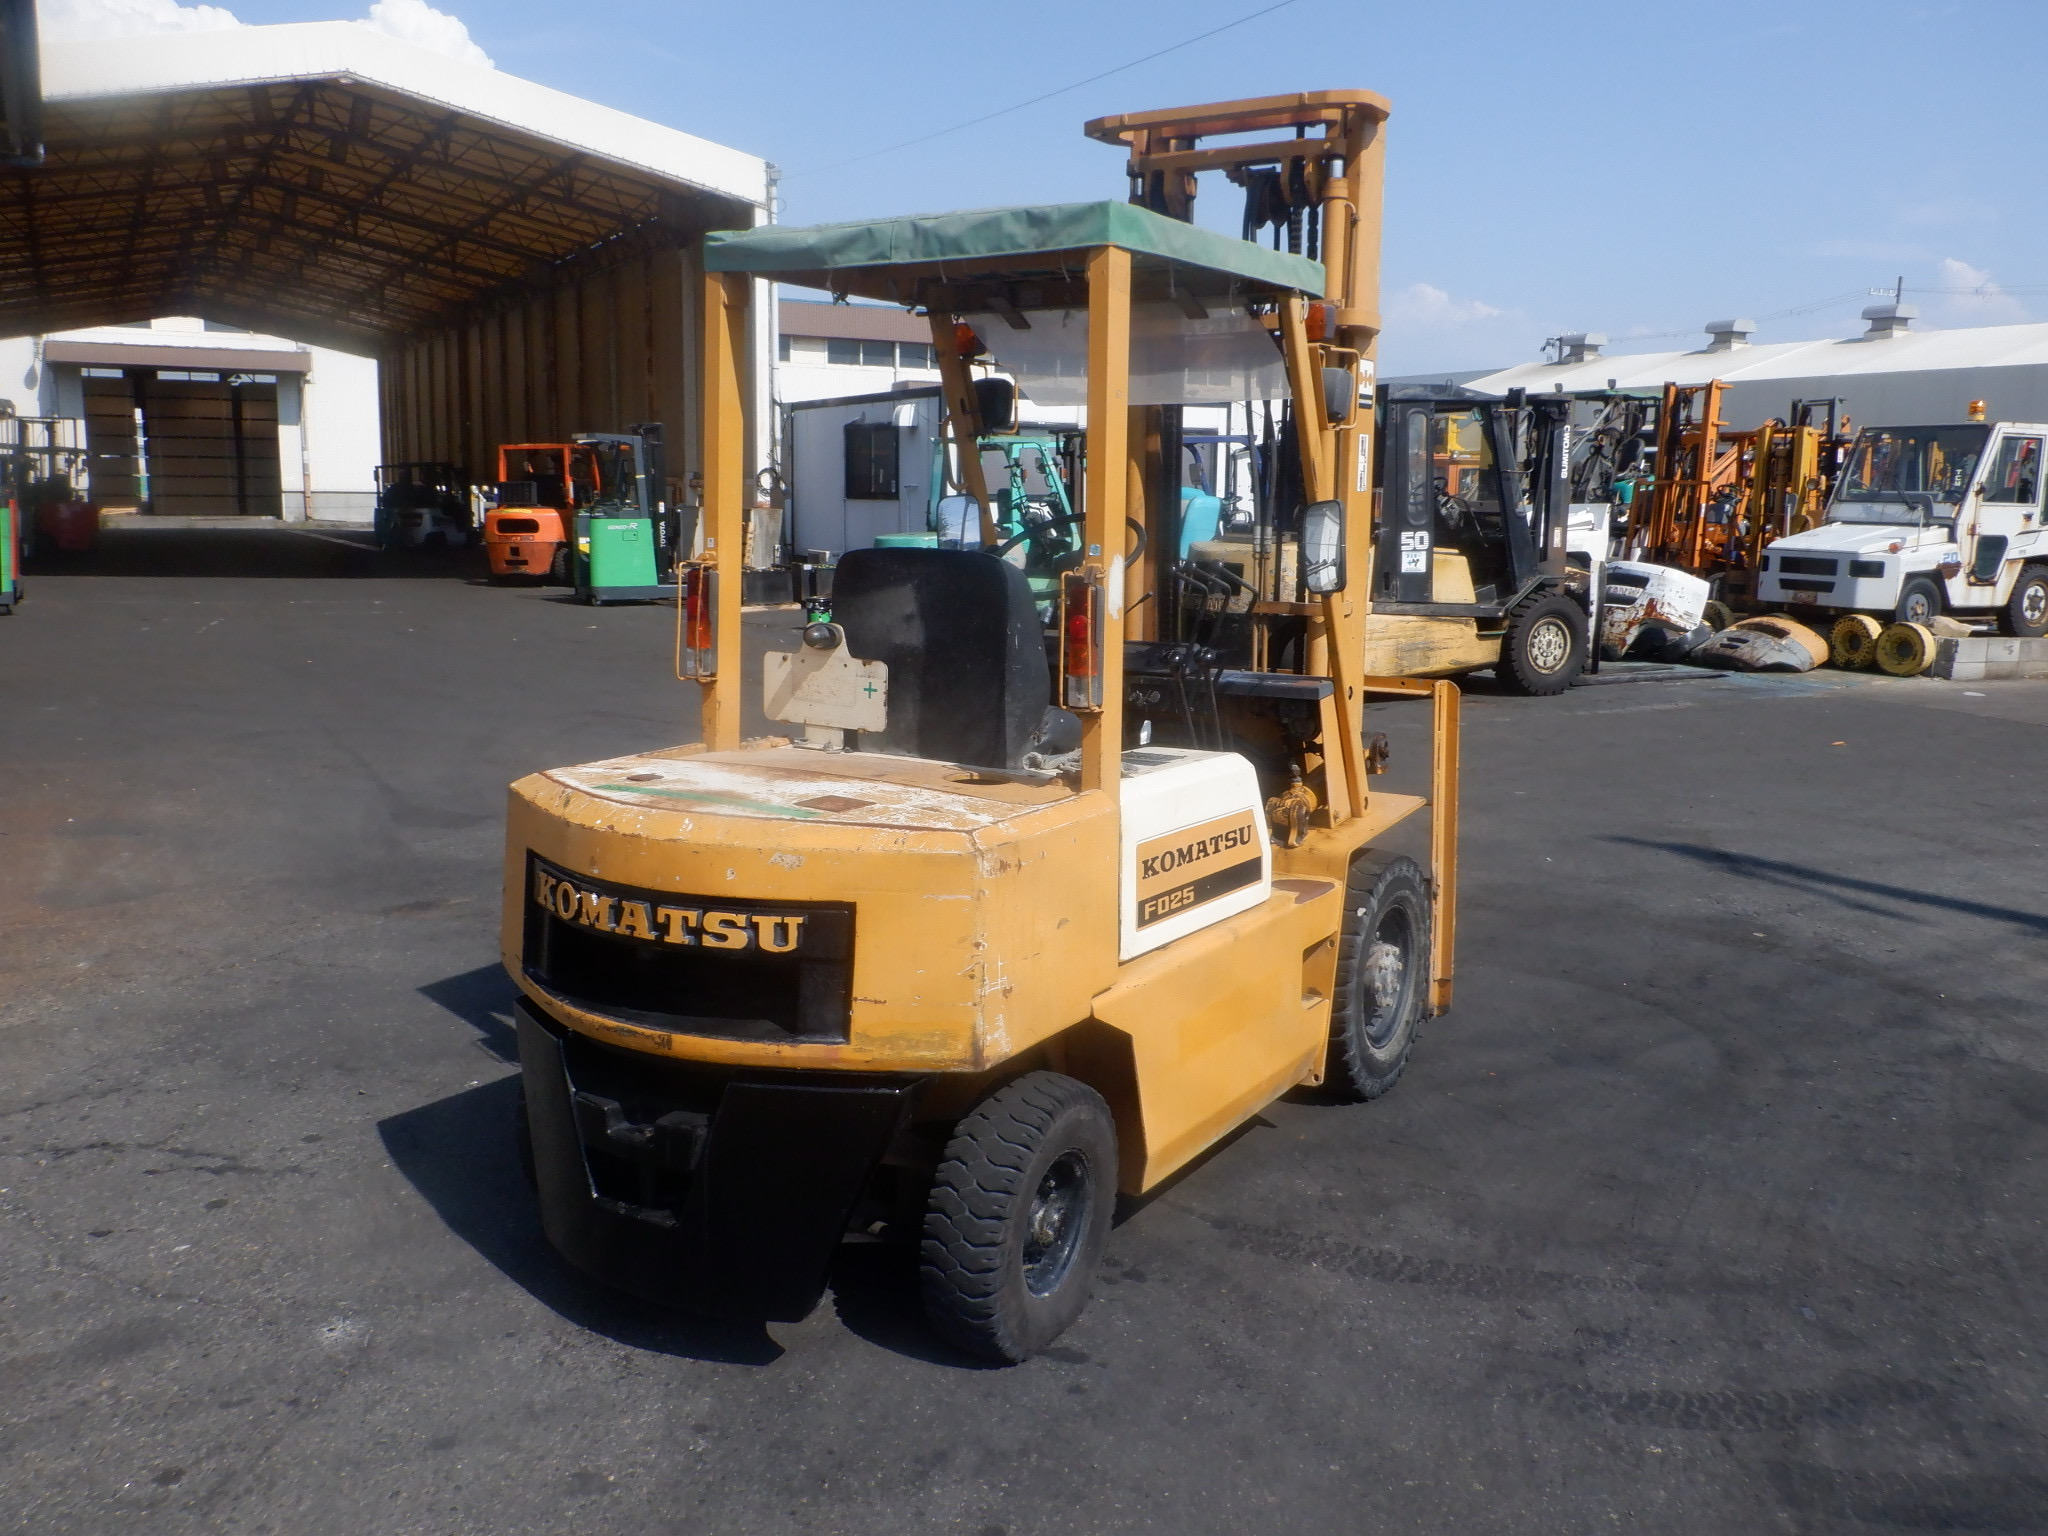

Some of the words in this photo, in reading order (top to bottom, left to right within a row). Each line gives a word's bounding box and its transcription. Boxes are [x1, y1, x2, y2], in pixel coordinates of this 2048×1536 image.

[1401, 531, 1429, 550] 50
[1942, 551, 1959, 563] 20
[1142, 824, 1253, 880] KOMATSU
[536, 870, 808, 953] KOMATSU
[1144, 886, 1195, 920] FD25
